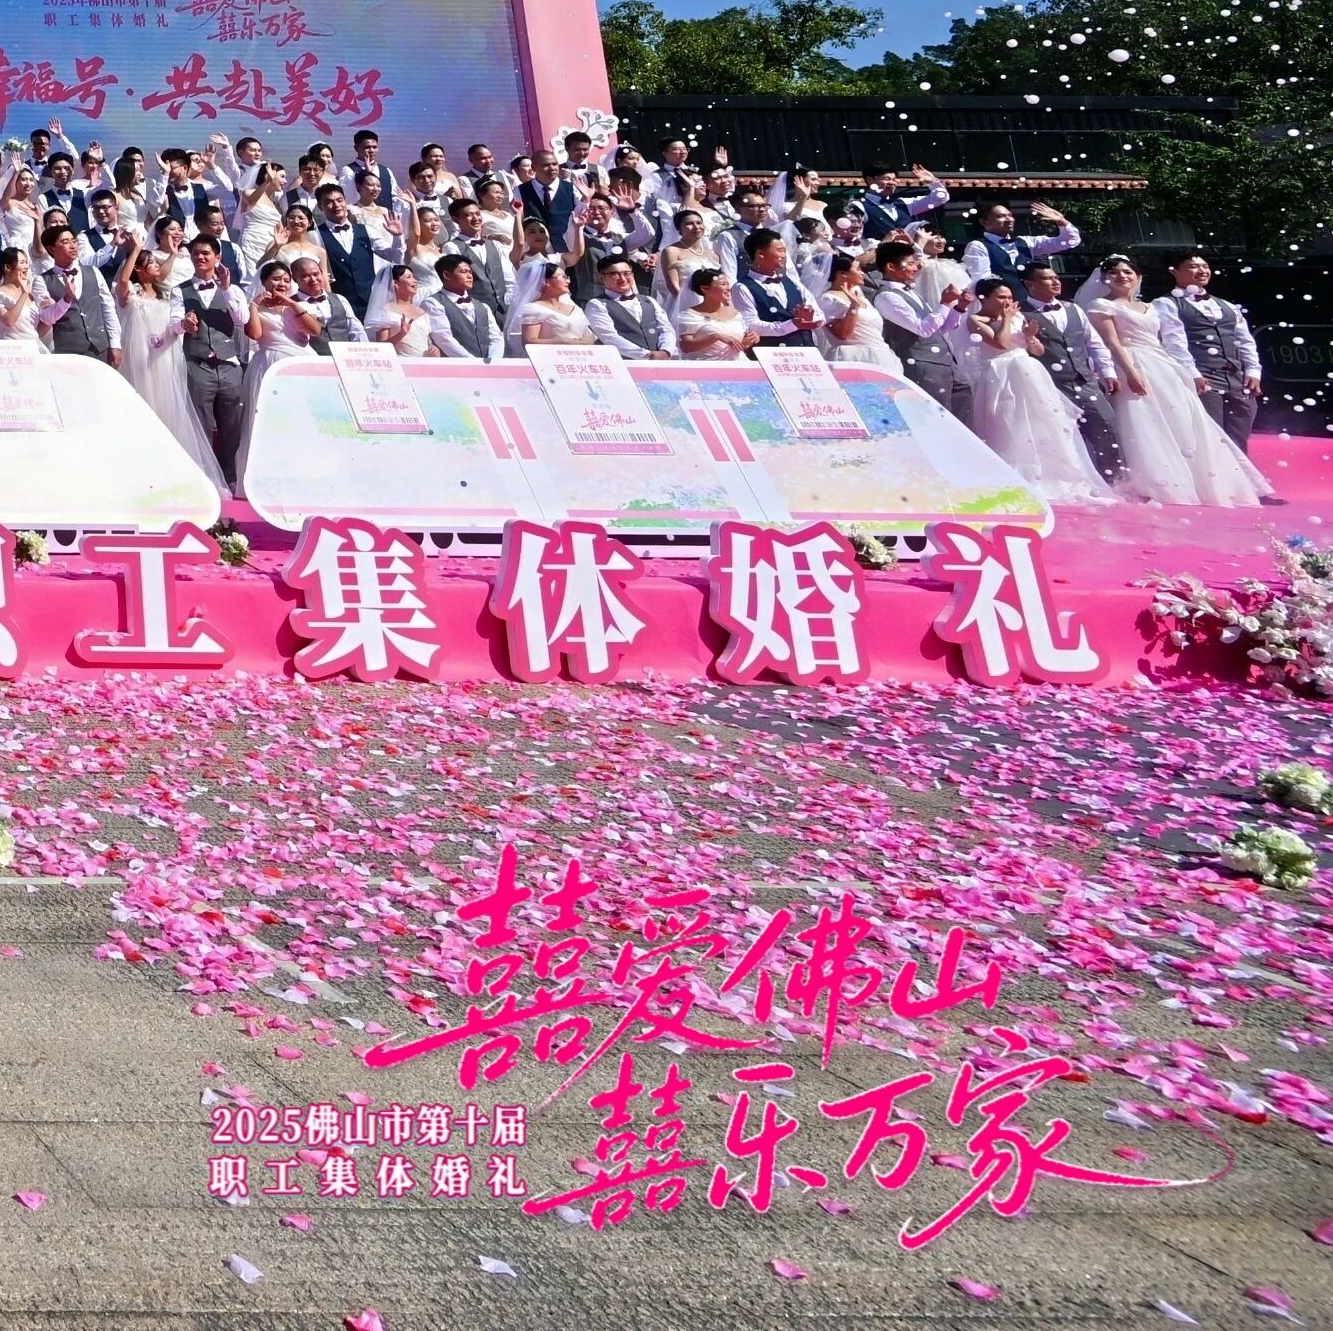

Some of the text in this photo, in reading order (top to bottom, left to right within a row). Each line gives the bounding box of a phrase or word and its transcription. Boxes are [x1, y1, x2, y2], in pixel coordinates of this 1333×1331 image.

[44, 13, 169, 28] 职工集体婚礼
[1266, 345, 1333, 365] 1903
[553, 364, 613, 375] 百年火车站
